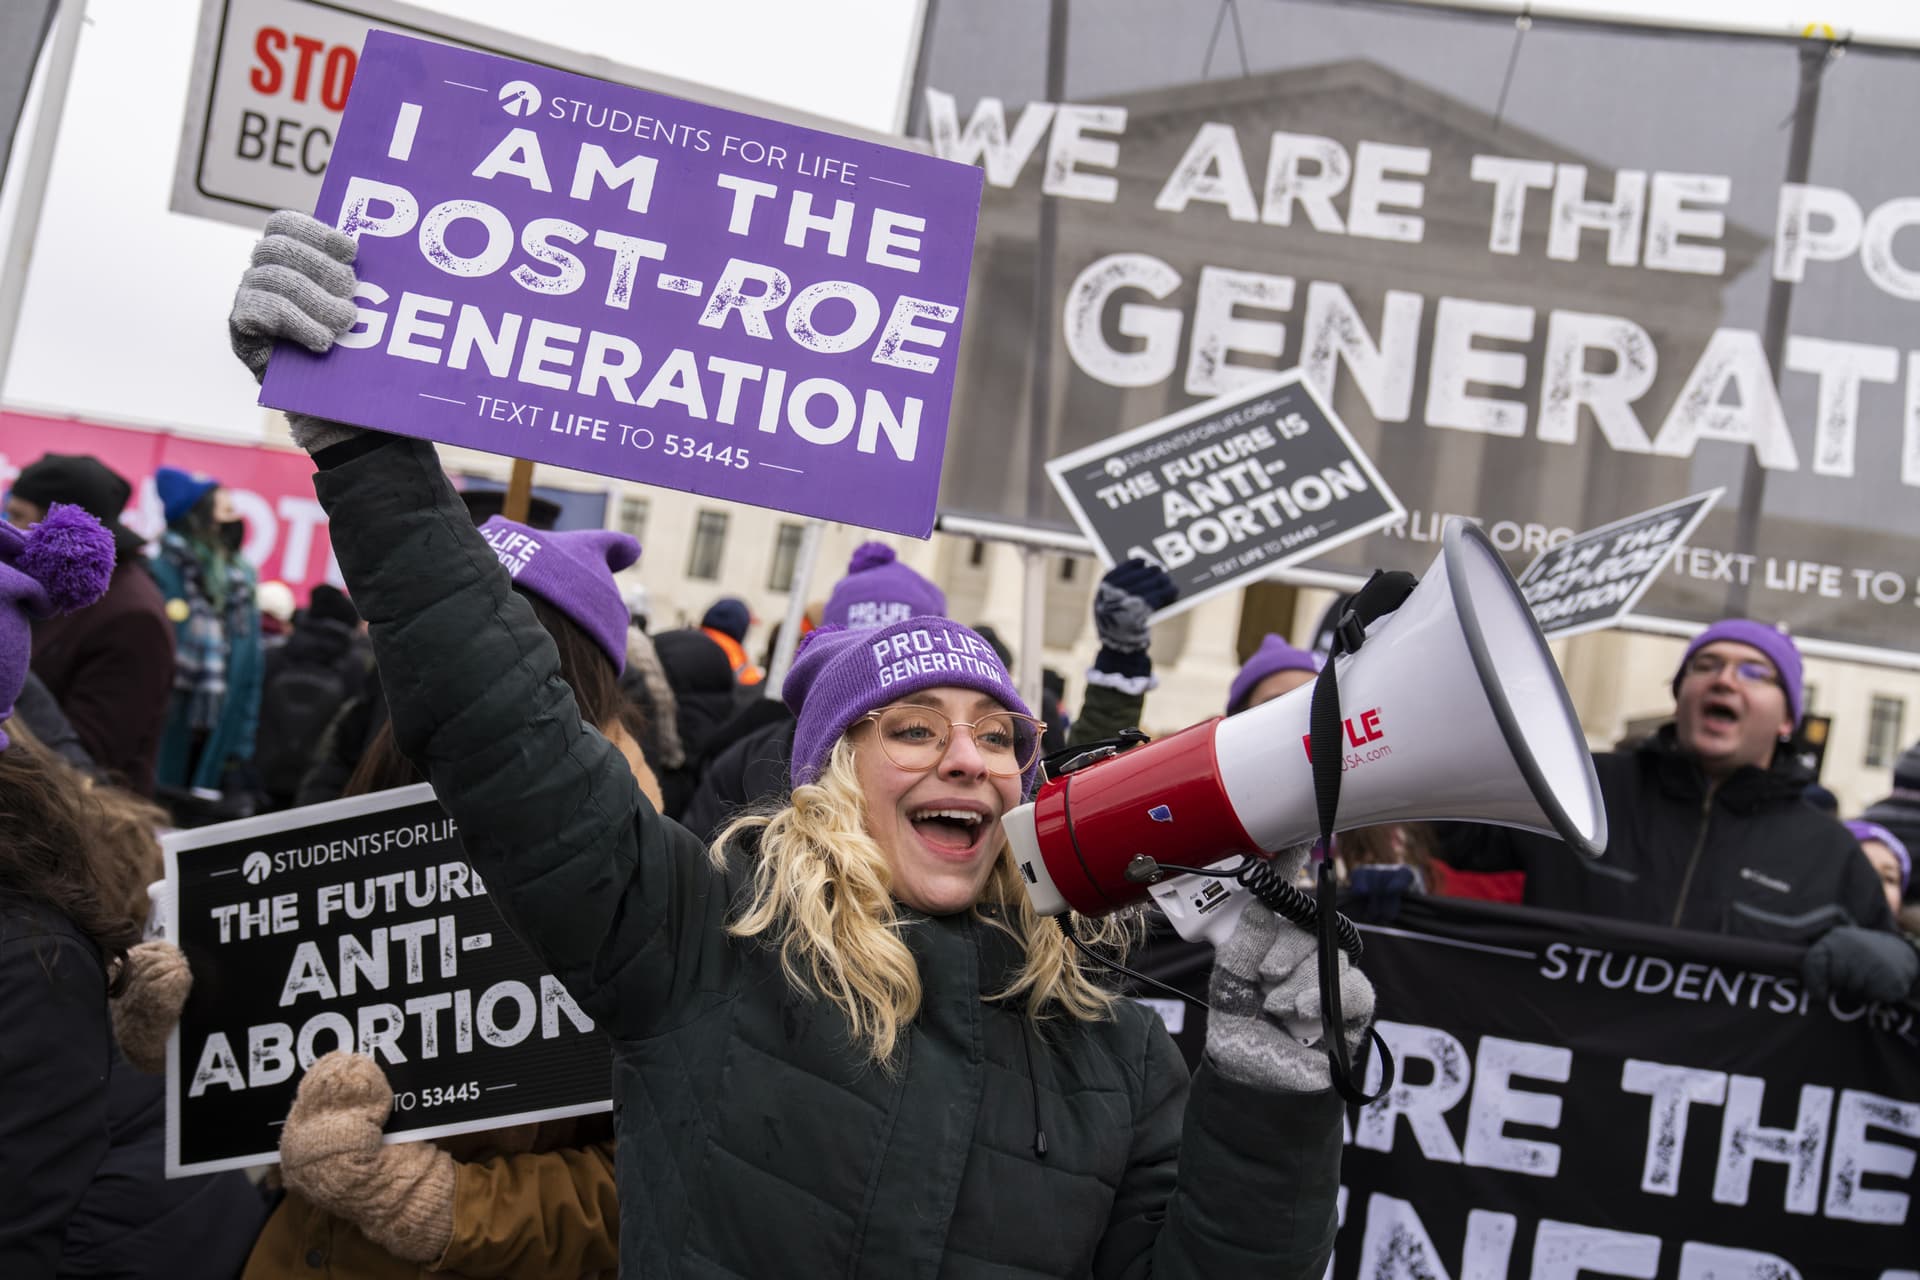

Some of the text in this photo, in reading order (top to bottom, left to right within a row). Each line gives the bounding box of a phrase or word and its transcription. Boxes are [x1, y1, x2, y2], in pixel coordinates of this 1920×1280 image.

[549, 97, 860, 185] STUDENTS FOR LIFE
[388, 102, 926, 273] I AM THE
[925, 86, 1128, 202] WE
[1154, 121, 1432, 242] ARE
[1471, 154, 1732, 275] THE
[335, 176, 959, 374] POST-ROE
[334, 281, 924, 461] GENERATION
[476, 395, 750, 469] TEXT LIFE TO 53445
[1096, 413, 1310, 509] THE FUTURE IS
[1127, 459, 1368, 573] ABORTION
[1162, 457, 1287, 528] ANTI-
[480, 528, 542, 562] -LIFE
[1210, 557, 1240, 577] TEXT
[1263, 541, 1282, 555] TO
[1521, 540, 1673, 604] OST-ROE
[1610, 516, 1682, 556] THE
[1671, 546, 1756, 586] TEXT
[1765, 557, 1842, 597] LIFE
[1852, 567, 1906, 603] TO
[872, 628, 996, 668] PRO-LIFE
[879, 653, 1002, 688] GENERATION
[210, 892, 299, 944] THE
[278, 915, 493, 1006] ANTI-
[187, 974, 595, 1098] ABORTION
[393, 1081, 480, 1112] TO 53445
[1342, 1019, 1920, 1225] RE THE
